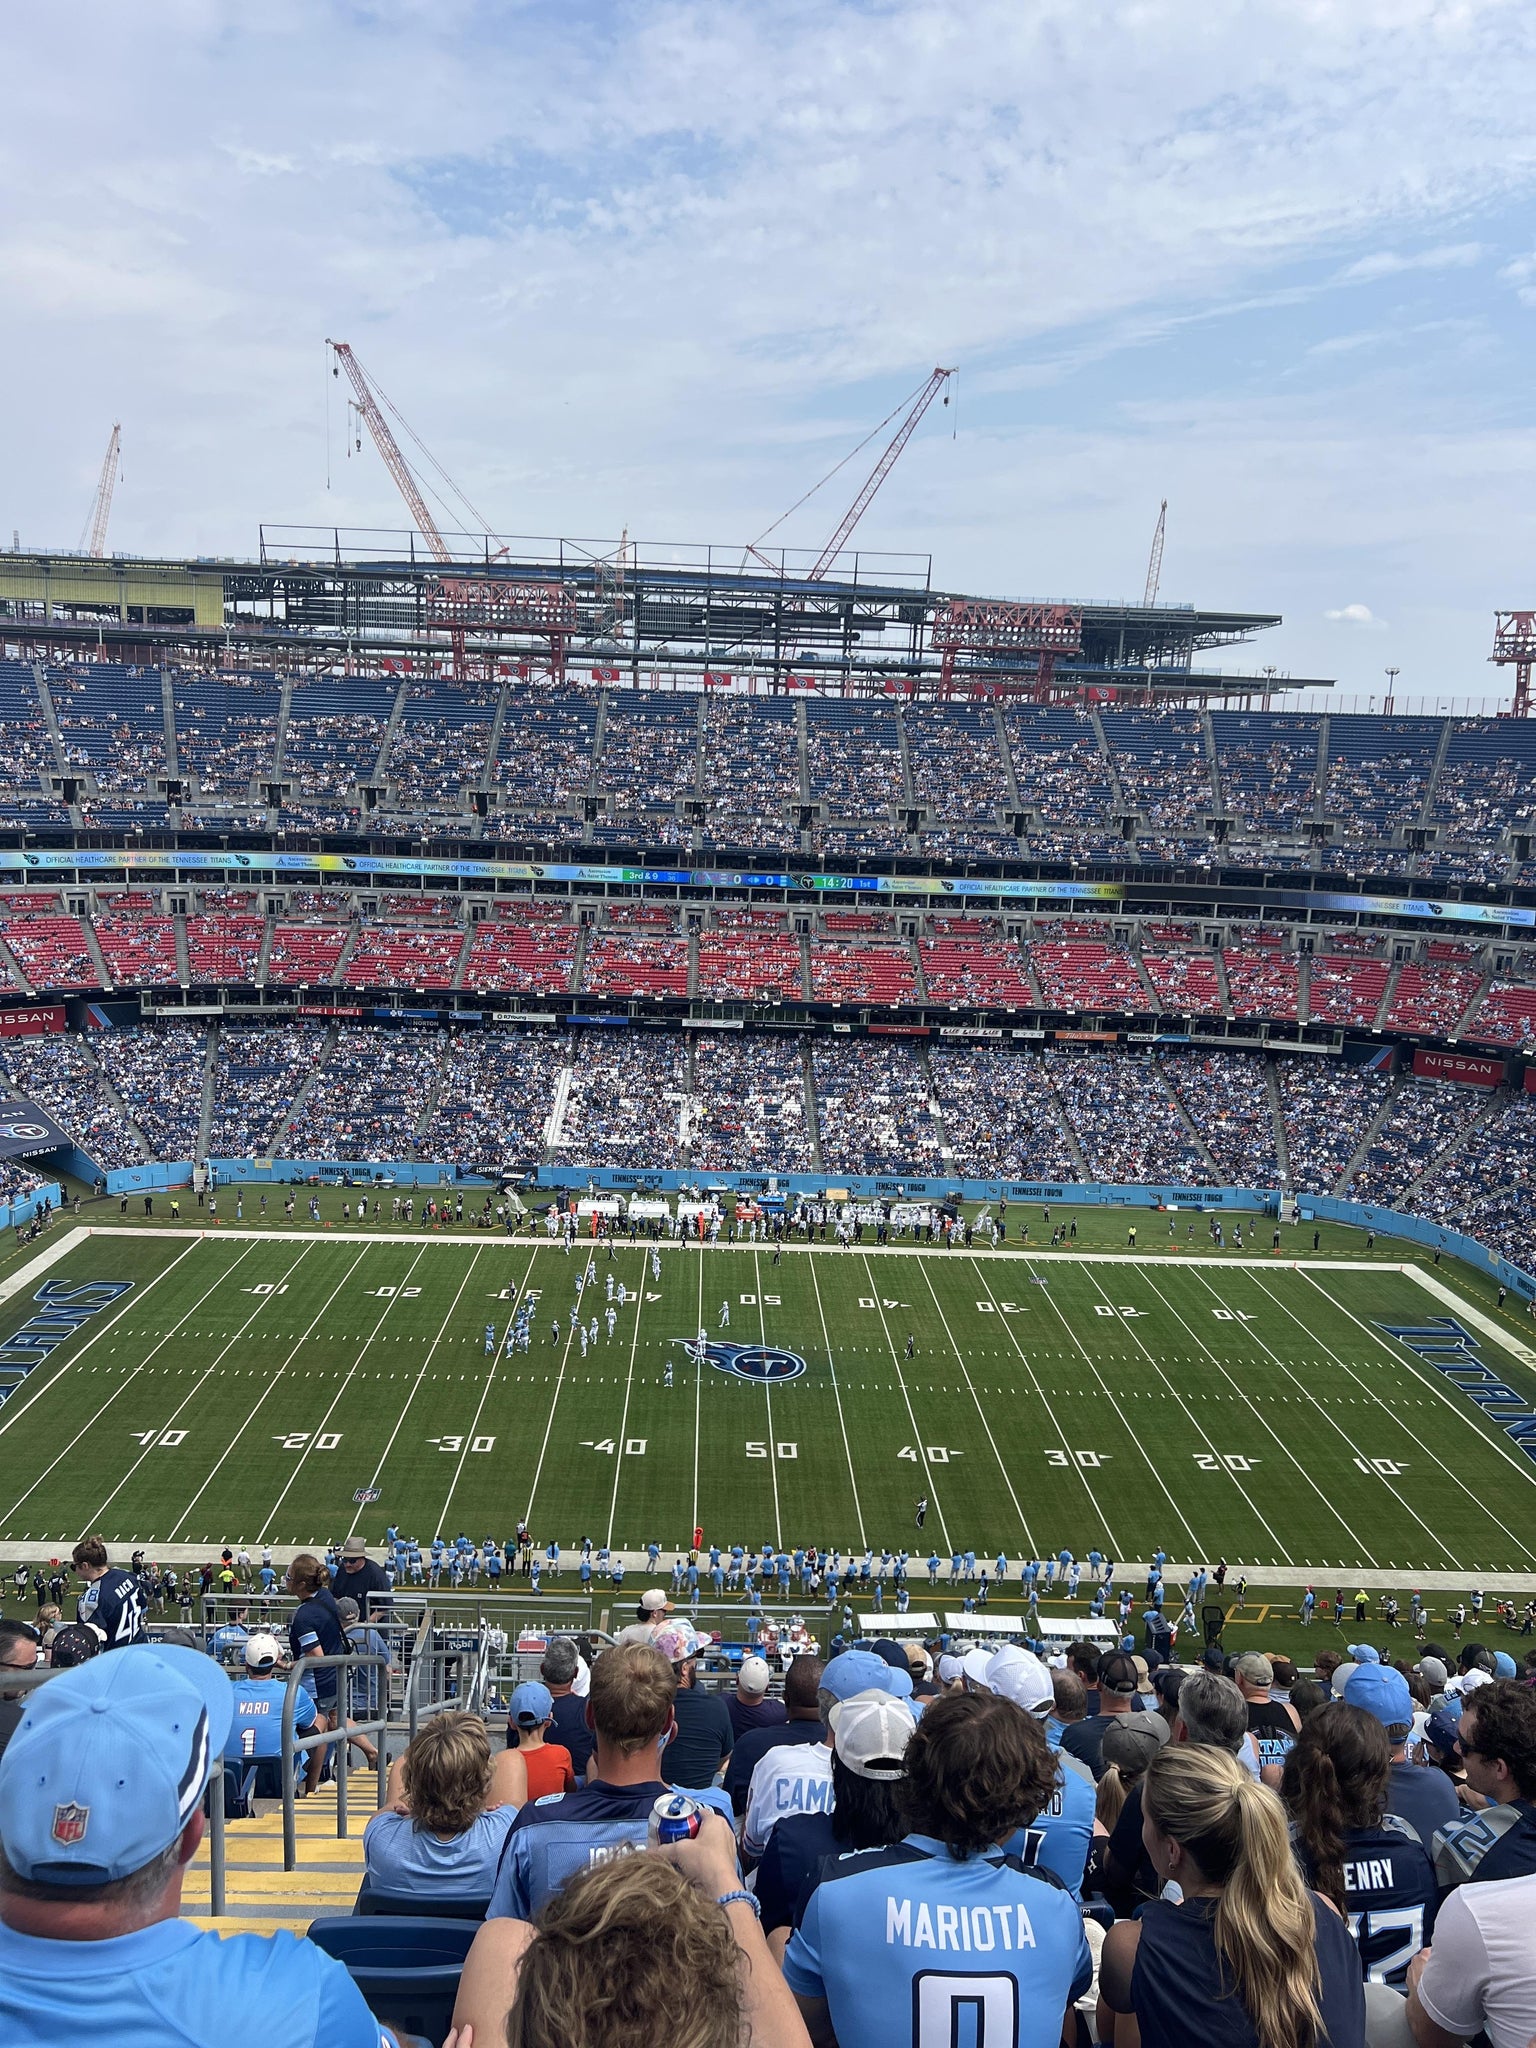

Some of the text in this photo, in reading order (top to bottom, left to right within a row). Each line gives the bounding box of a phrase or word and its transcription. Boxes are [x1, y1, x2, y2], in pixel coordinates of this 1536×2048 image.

[386, 862, 422, 870] HEALTHCARE
[629, 871, 643, 880] 3rd
[652, 872, 658, 880] 9
[1402, 903, 1424, 913] TITANS
[1425, 1056, 1492, 1074] NISSAN
[23, 1146, 57, 1158] NISSAN
[908, 1184, 926, 1192] TOUGH
[1012, 1187, 1063, 1197] TENNESSEE TOUGH
[1172, 1193, 1223, 1202] TENNESSEE TOUGH
[143, 1430, 190, 1446] 10
[283, 1433, 344, 1450] 20
[438, 1436, 496, 1452] 30
[593, 1439, 648, 1455] 40
[746, 1441, 798, 1459] 50
[897, 1446, 949, 1463] 40
[1044, 1450, 1100, 1467] 30
[1192, 1453, 1251, 1472] 20
[1353, 1458, 1402, 1475] 10
[239, 1702, 270, 1715] WARD
[240, 1728, 256, 1756] 1
[56, 1821, 83, 1840] NFL
[1342, 1858, 1394, 1892] ENRY
[886, 1896, 1036, 1950] MARIOTA
